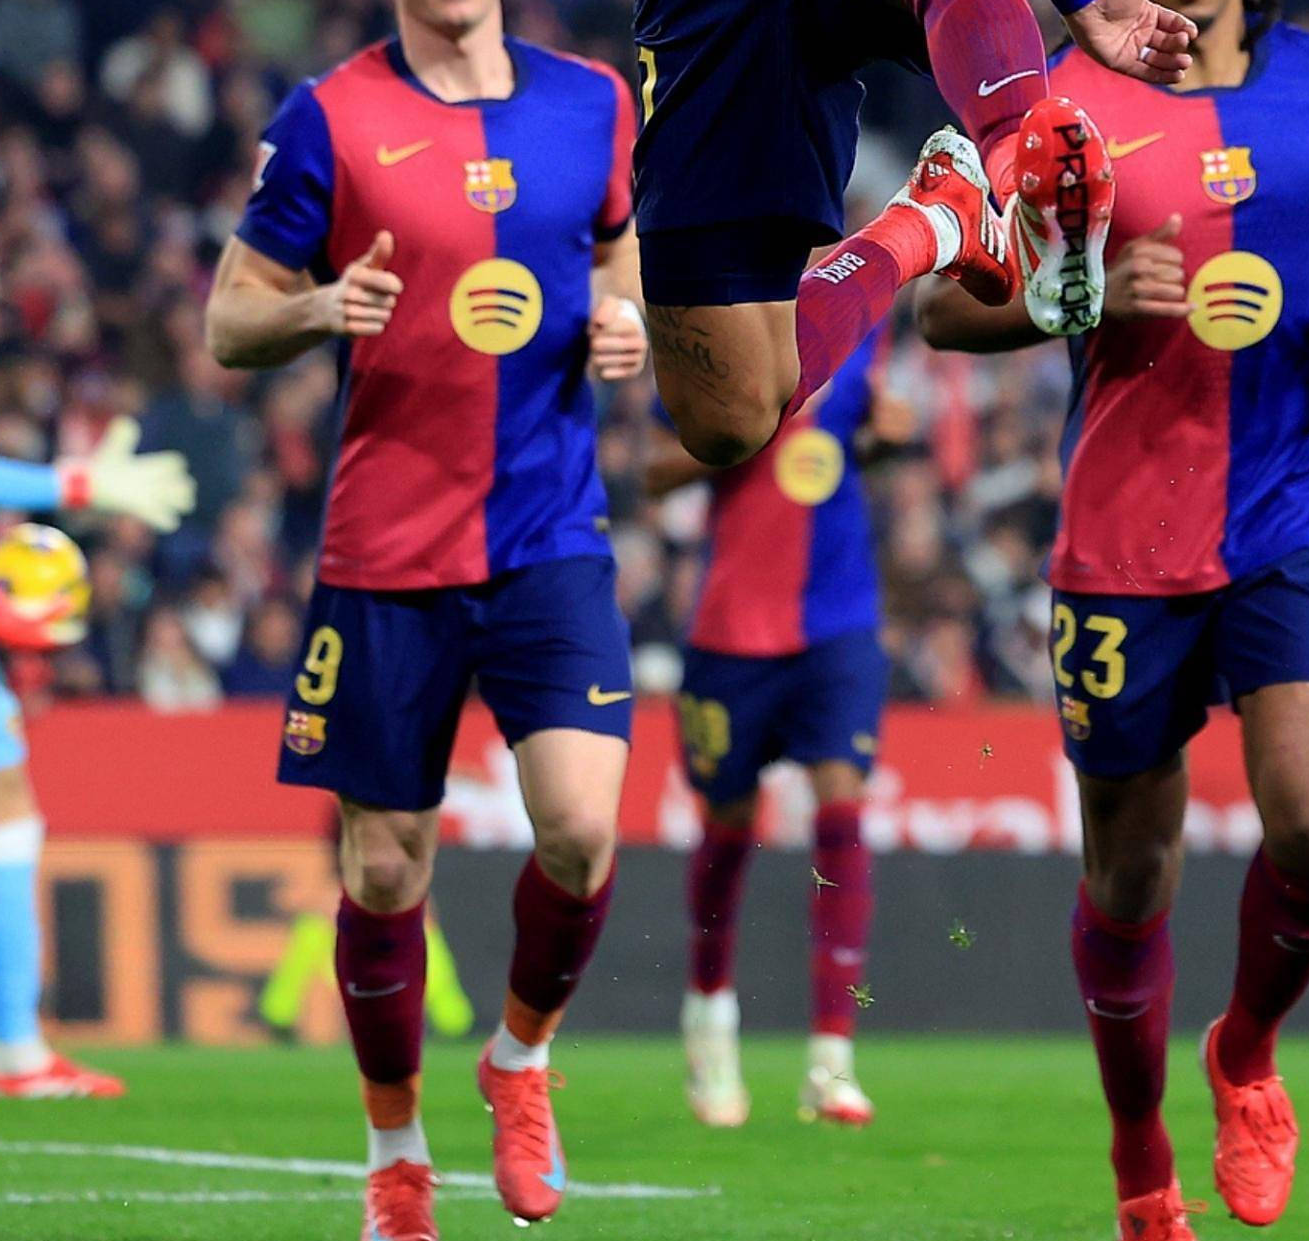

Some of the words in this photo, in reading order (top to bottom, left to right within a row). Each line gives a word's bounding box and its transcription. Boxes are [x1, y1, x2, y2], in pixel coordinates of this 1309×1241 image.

[1052, 123, 1091, 332] PREDATOR
[295, 626, 343, 706] 9
[1053, 603, 1128, 699] 23
